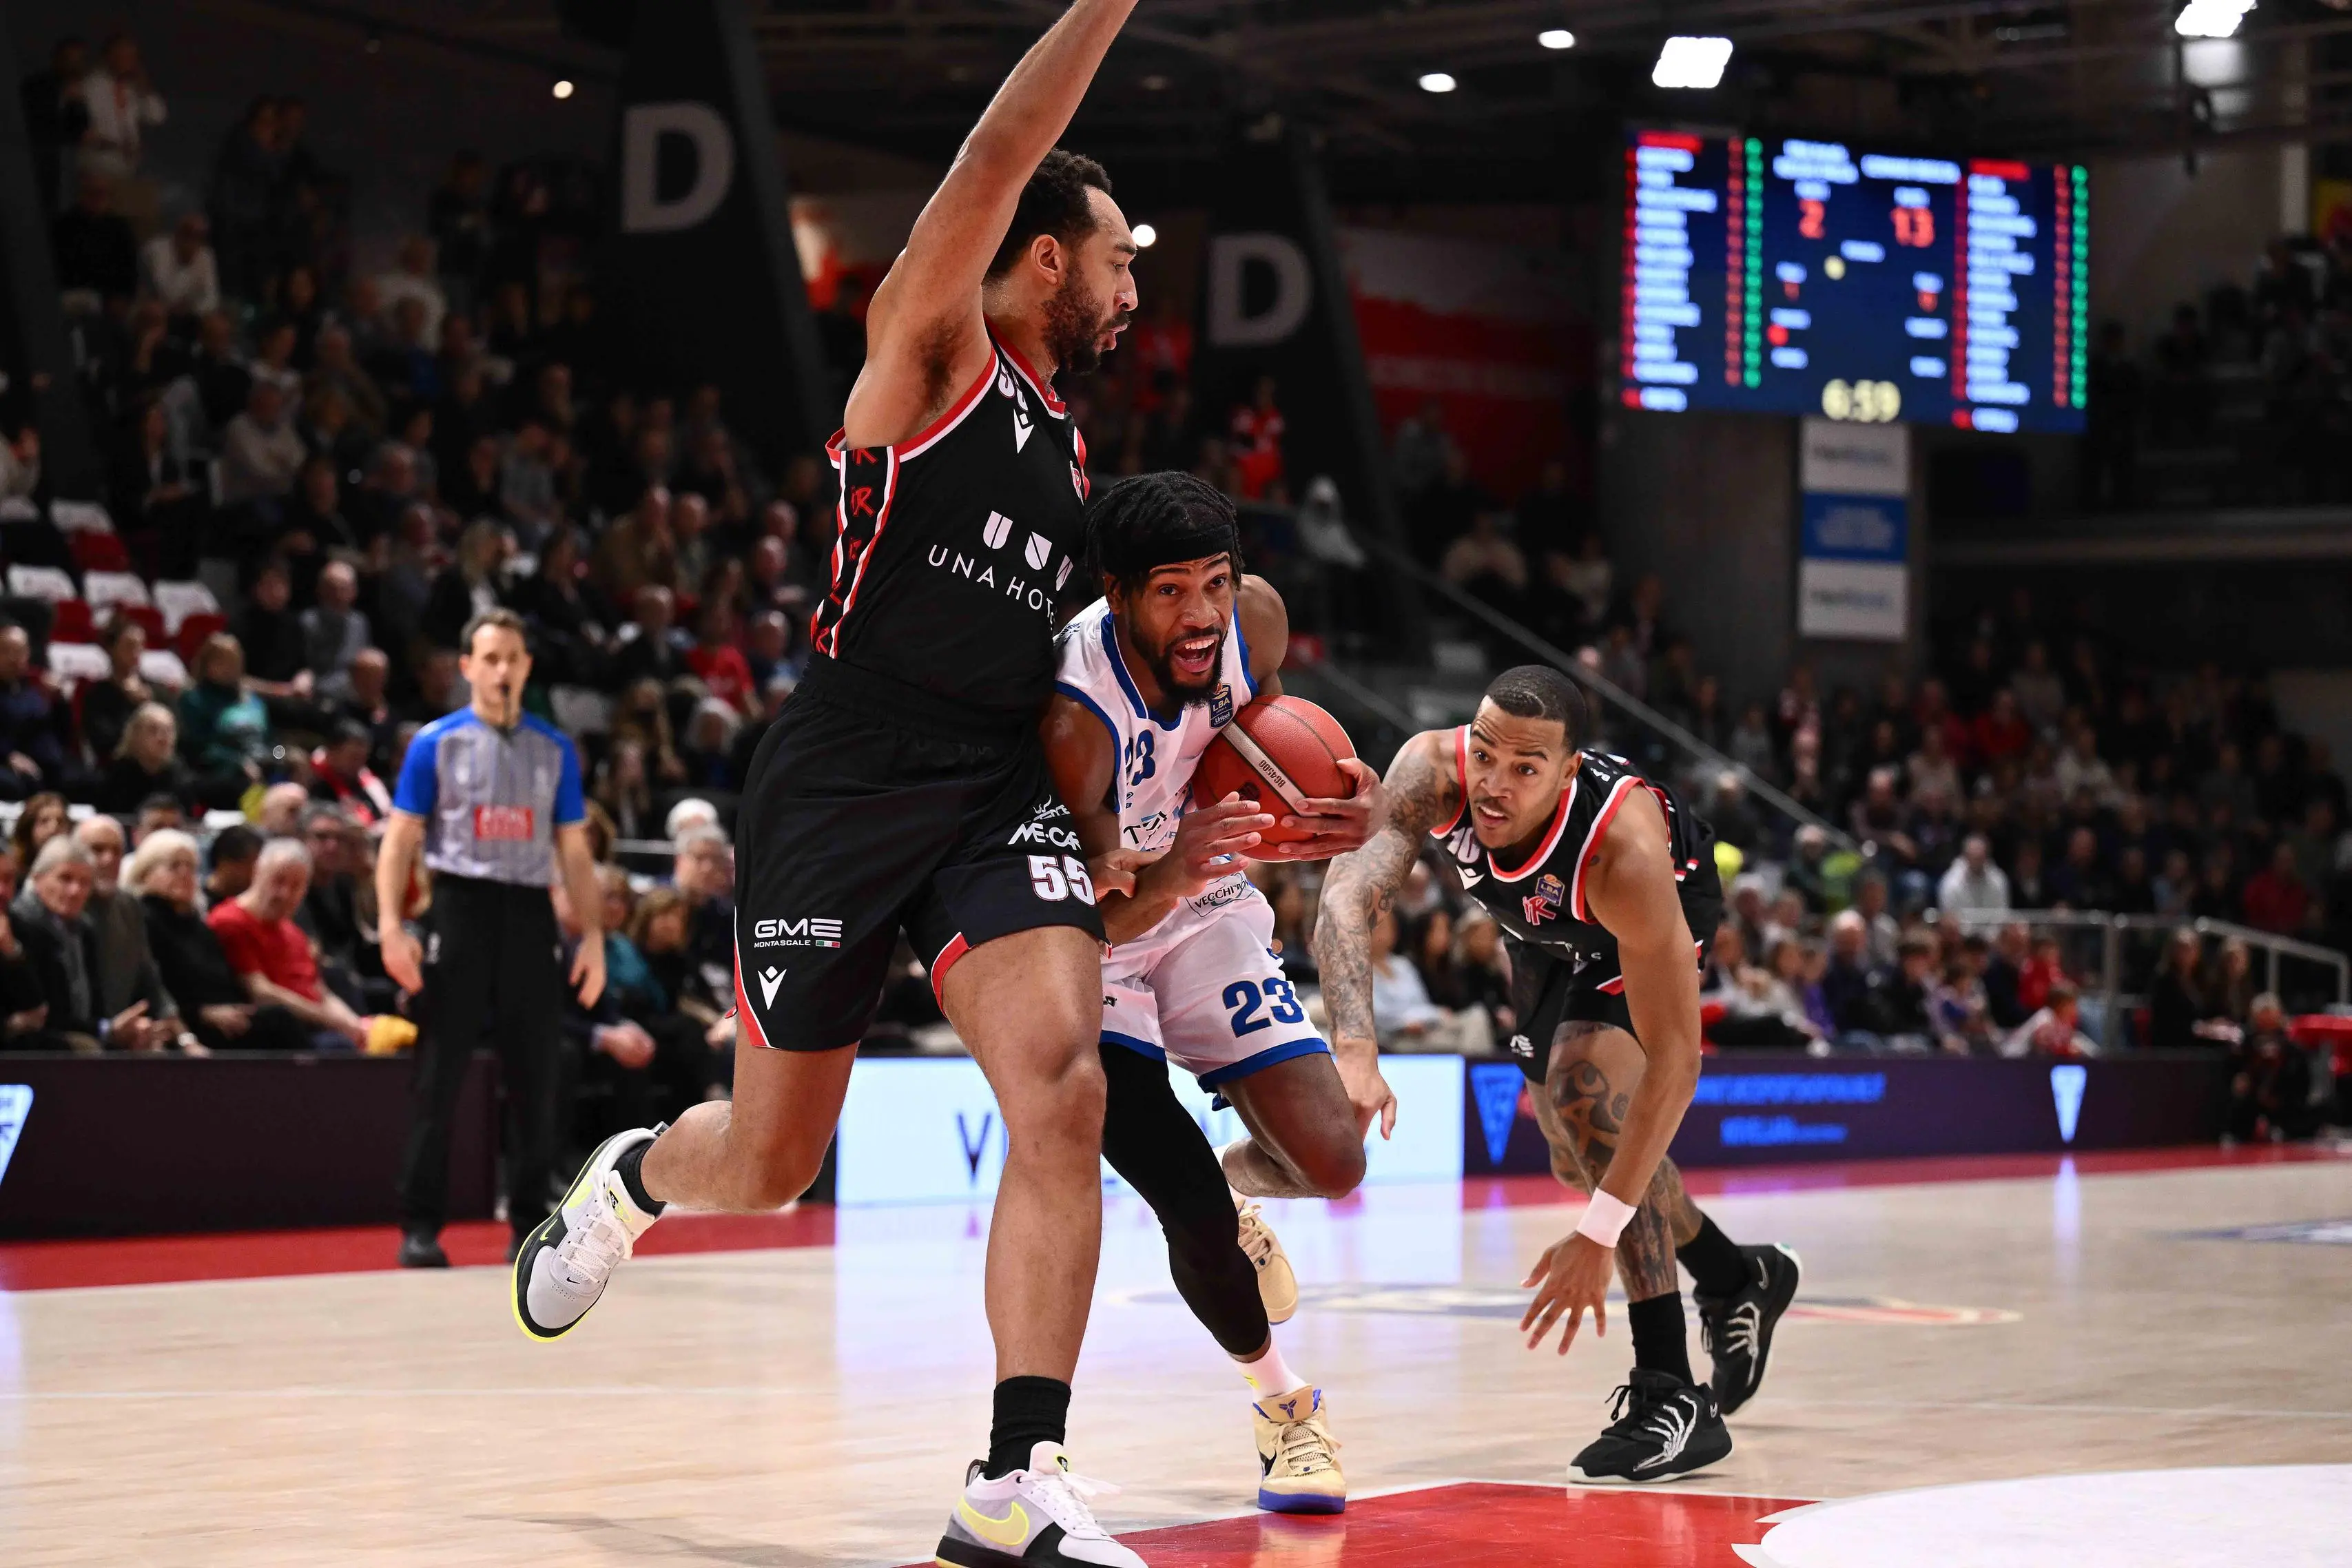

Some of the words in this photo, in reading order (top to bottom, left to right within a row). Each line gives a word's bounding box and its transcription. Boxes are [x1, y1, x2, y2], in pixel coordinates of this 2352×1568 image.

[623, 102, 734, 231] D
[1210, 232, 1312, 346] D
[929, 544, 994, 588] UNA
[1213, 697, 1230, 712] LBA
[1215, 712, 1230, 724] Unipol
[1259, 759, 1286, 787] BG4500
[1027, 854, 1096, 907] 55
[754, 918, 843, 938] GME
[754, 940, 811, 948] MONTASCALE
[1221, 977, 1305, 1038] 23
